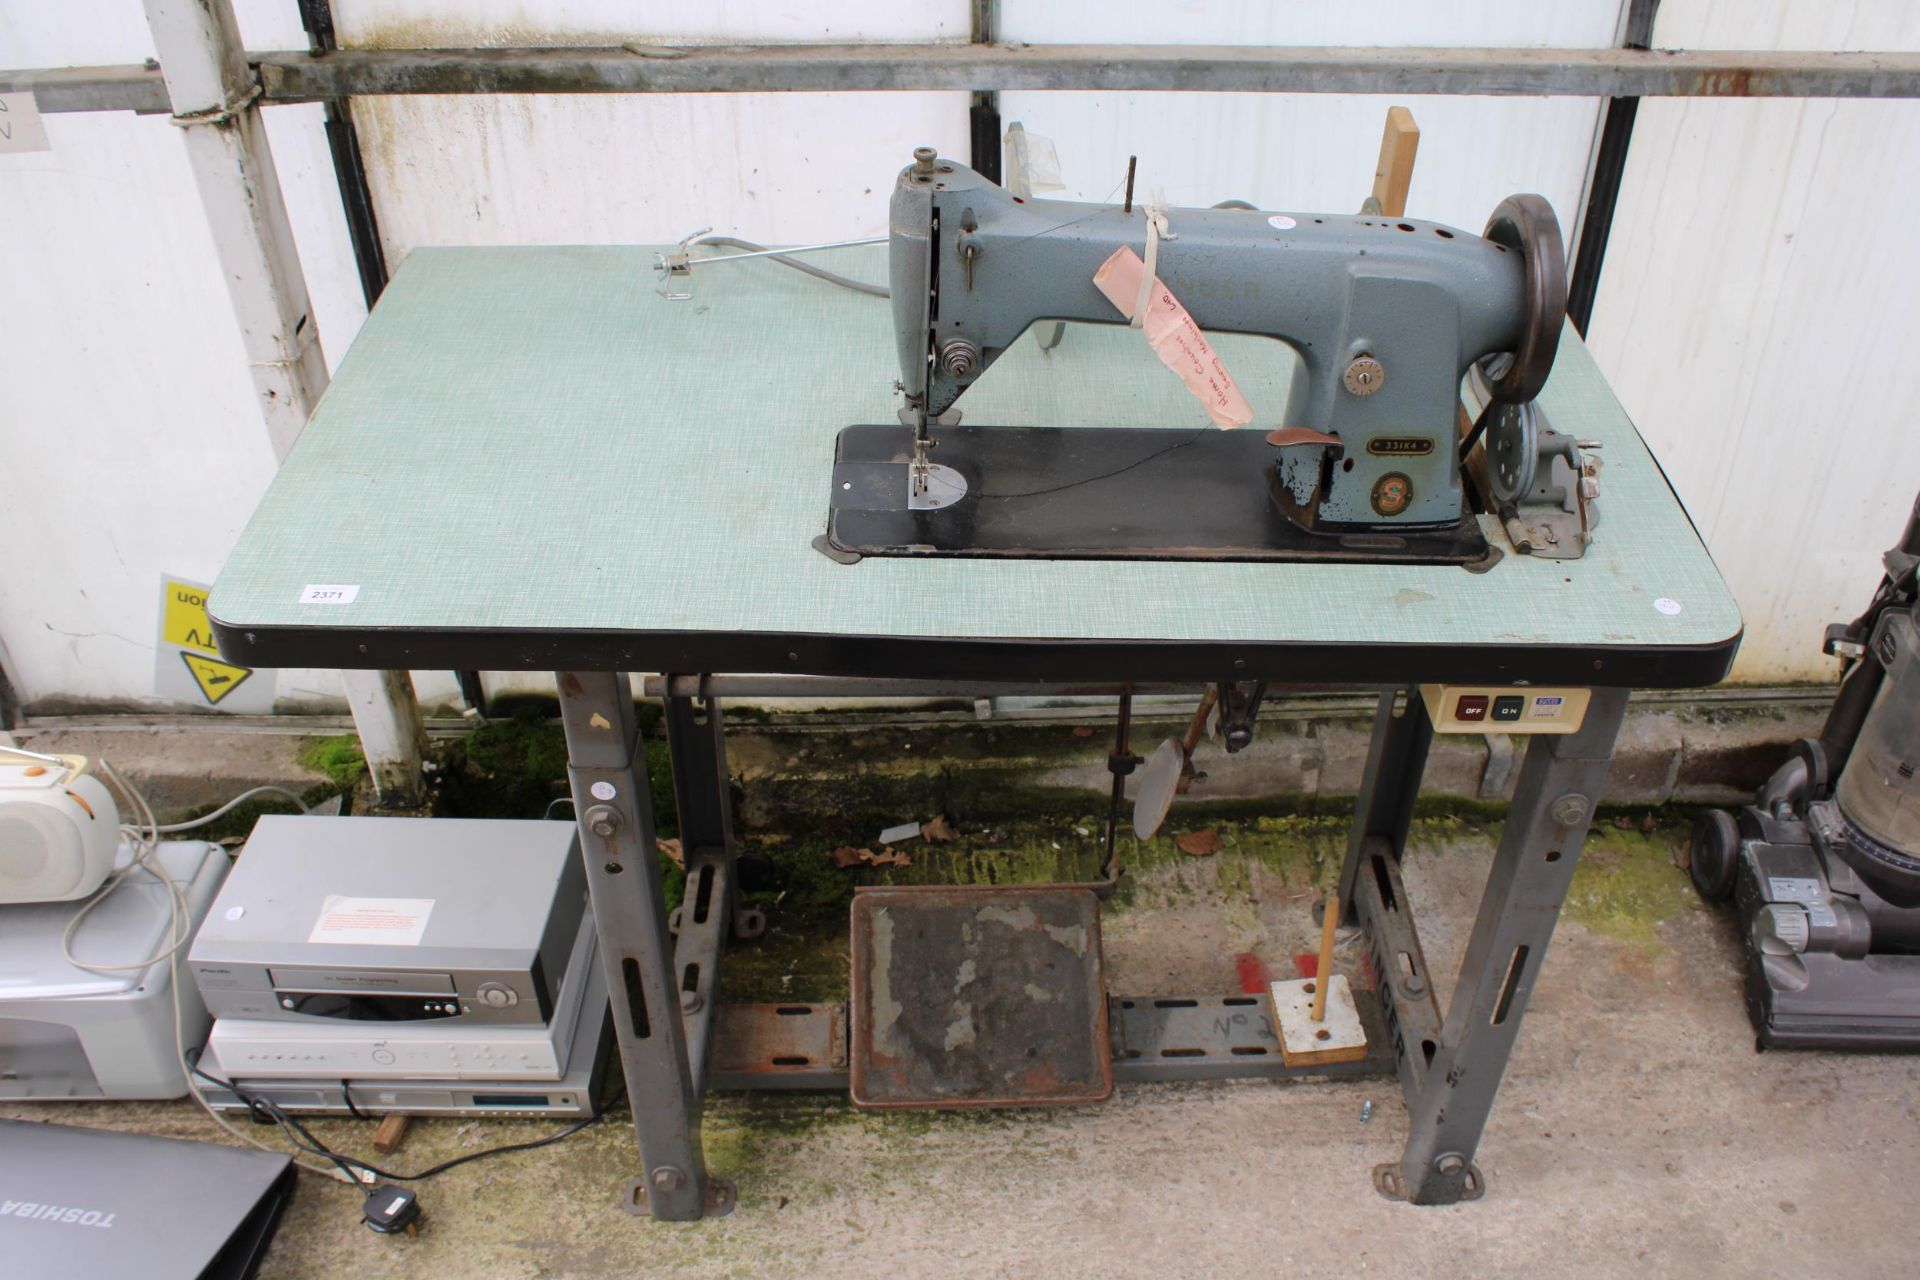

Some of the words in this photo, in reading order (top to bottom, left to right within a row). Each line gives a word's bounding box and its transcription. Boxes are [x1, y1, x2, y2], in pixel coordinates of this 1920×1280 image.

[1161, 275, 1260, 300] INGER
[1208, 376, 1228, 407] Home
[311, 591, 344, 599] 2371
[185, 628, 217, 649] TV
[1364, 916, 1405, 1058] SINGER
[0, 1200, 116, 1228] TOSHIBA
